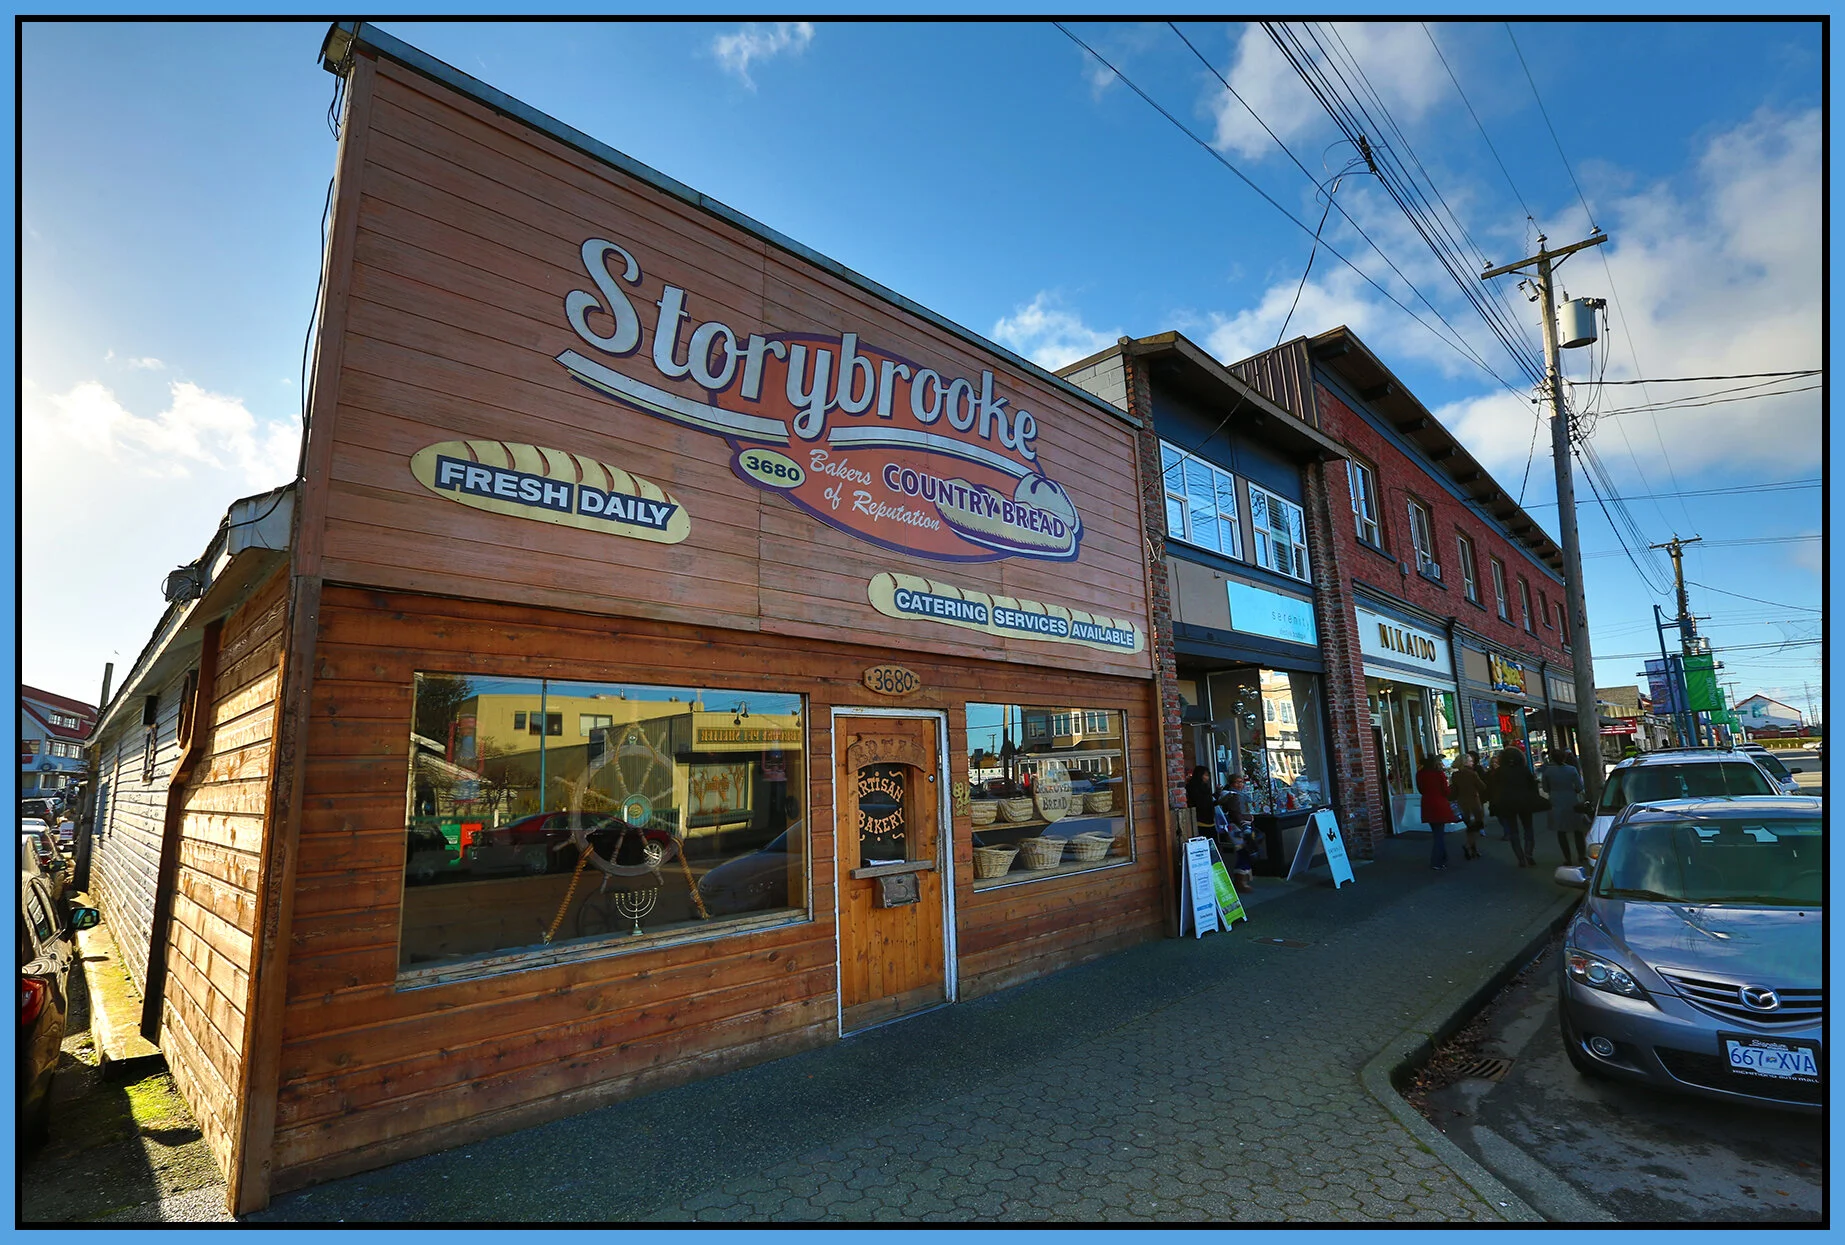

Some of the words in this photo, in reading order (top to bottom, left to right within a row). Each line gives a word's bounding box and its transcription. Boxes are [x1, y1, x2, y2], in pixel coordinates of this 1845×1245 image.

[565, 237, 1038, 463] Storybrooke
[745, 454, 801, 483] 3680
[808, 448, 872, 487] Bakers
[440, 460, 569, 508] FRESH
[580, 489, 671, 526] DAILY
[823, 482, 843, 511] of
[852, 490, 941, 533] Reputation
[882, 462, 998, 519] COUNTRY
[1002, 500, 1067, 540] BREAD
[895, 590, 988, 623] CATERING
[994, 606, 1068, 634] SERVICES
[1071, 623, 1135, 647] AVAILABLE
[1378, 623, 1436, 662] NIKAIDO
[873, 668, 914, 693] 3680
[1731, 1048, 1764, 1066] 667
[1776, 1052, 1816, 1072] XVA
